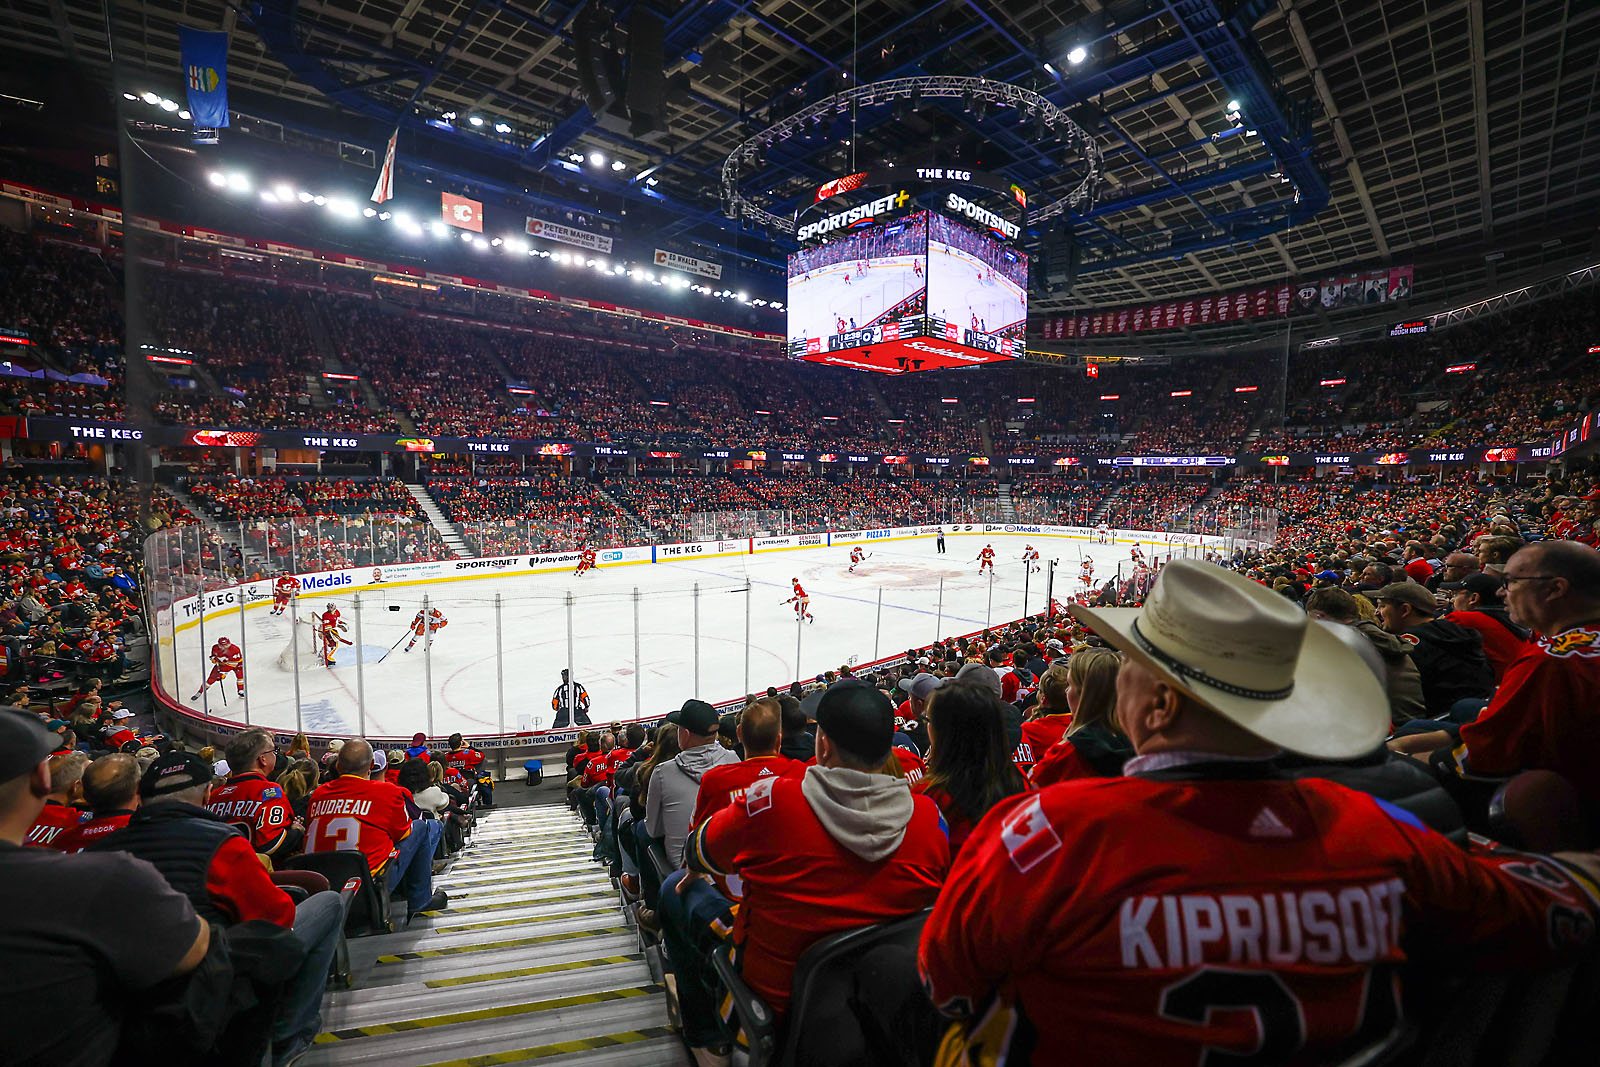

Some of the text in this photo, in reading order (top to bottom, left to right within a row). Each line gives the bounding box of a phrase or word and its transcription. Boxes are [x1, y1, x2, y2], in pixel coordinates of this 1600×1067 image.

[917, 168, 971, 181] THE KEG
[948, 193, 1021, 239] SPORTSNET
[544, 223, 595, 242] PETER MAHER
[677, 256, 698, 266] WHALEN
[1390, 326, 1427, 337] ROUGH HOUSE
[70, 426, 143, 439] THE KEG
[303, 437, 357, 447] THE KEG
[467, 442, 510, 452] THE KEG
[1531, 448, 1542, 457] THE
[1333, 456, 1350, 464] KEG
[662, 545, 703, 556] THE KEG
[455, 558, 518, 570] SPORTSNET
[558, 554, 582, 562] albert
[302, 572, 352, 591] Medals
[182, 600, 207, 617] THE
[208, 593, 234, 608] KEG
[483, 740, 502, 748] POWER
[547, 733, 567, 743] OPA!
[310, 799, 372, 817] GAUDREAU
[256, 806, 284, 830] 18
